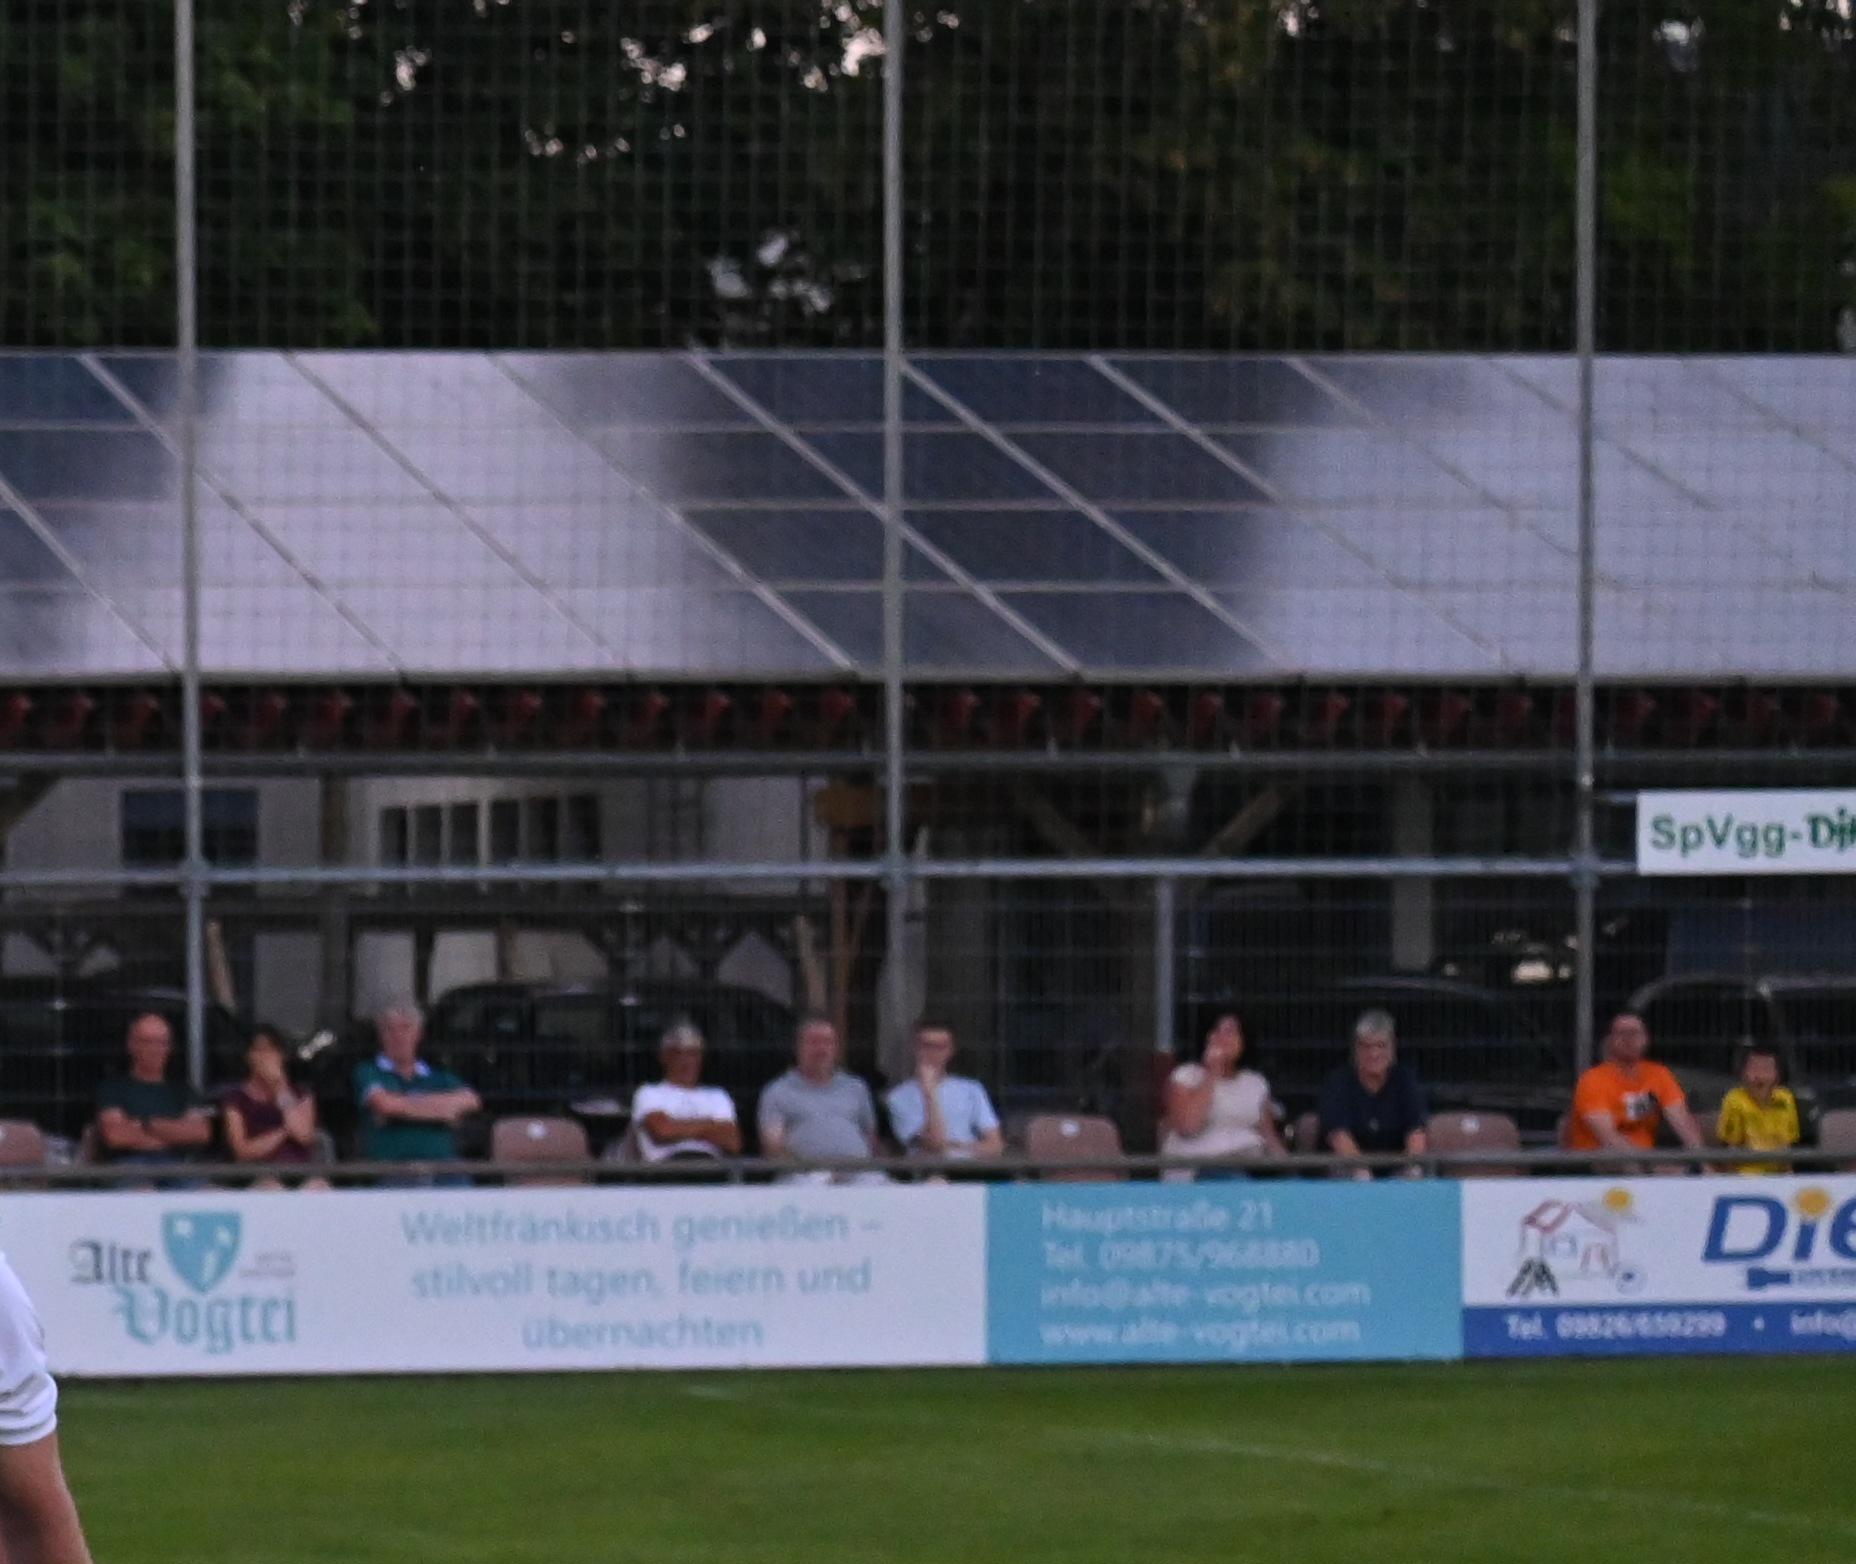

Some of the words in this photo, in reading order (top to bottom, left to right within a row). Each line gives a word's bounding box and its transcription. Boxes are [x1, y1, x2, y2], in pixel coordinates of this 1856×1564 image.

[1237, 1198, 1274, 1231] 21
[797, 1256, 873, 1296] und
[521, 1313, 766, 1351] übernachten
